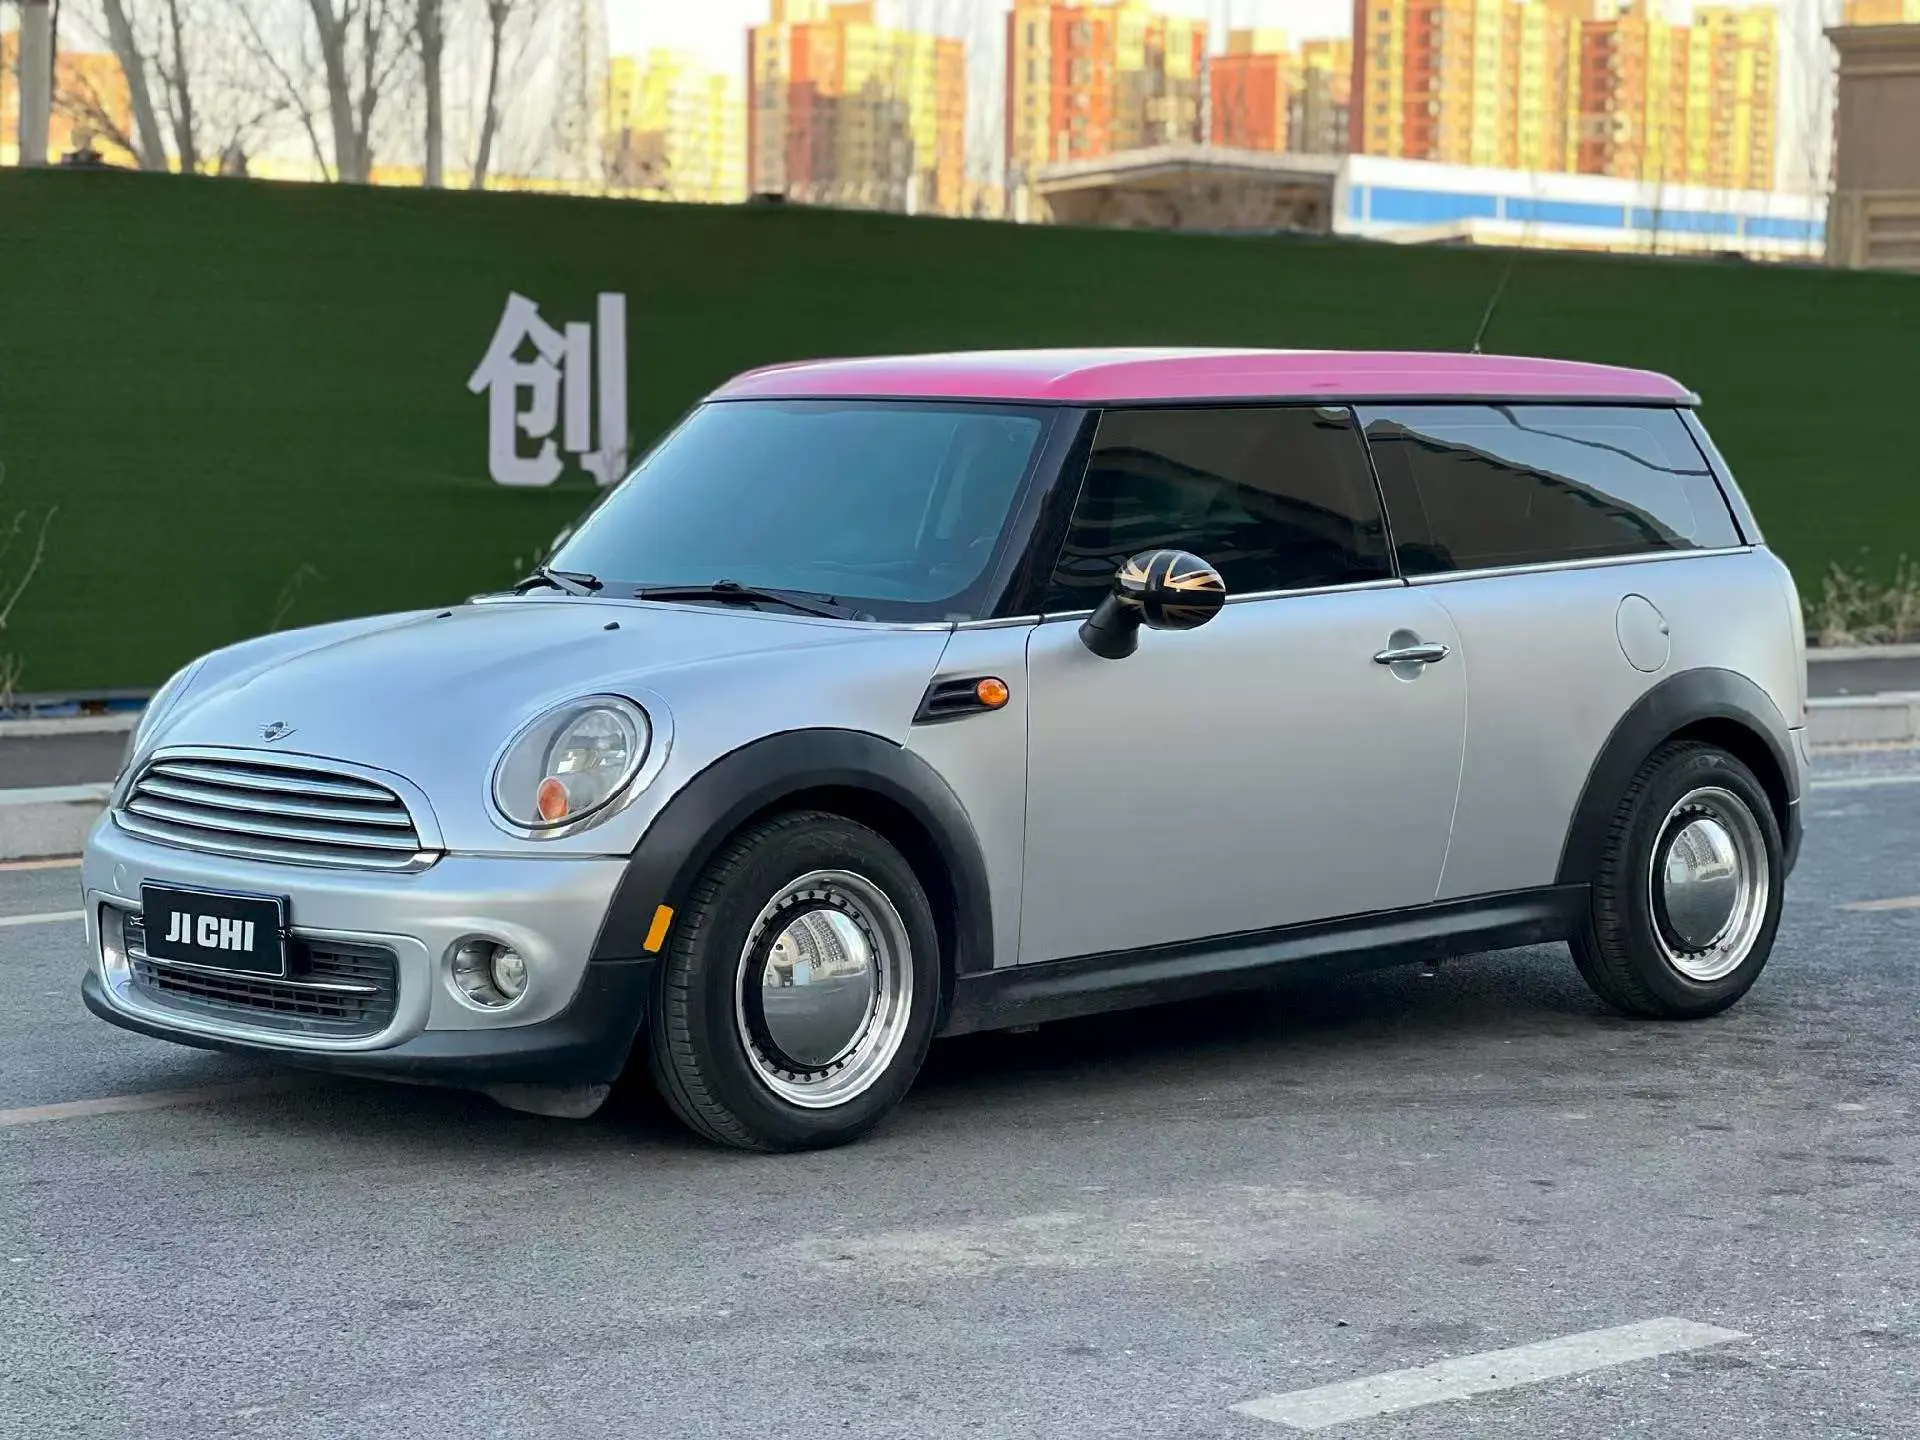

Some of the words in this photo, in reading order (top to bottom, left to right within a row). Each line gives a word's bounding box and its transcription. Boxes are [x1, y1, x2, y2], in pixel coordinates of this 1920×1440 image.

[466, 291, 627, 486] 创
[166, 912, 191, 944] JI
[197, 915, 255, 951] CHI
